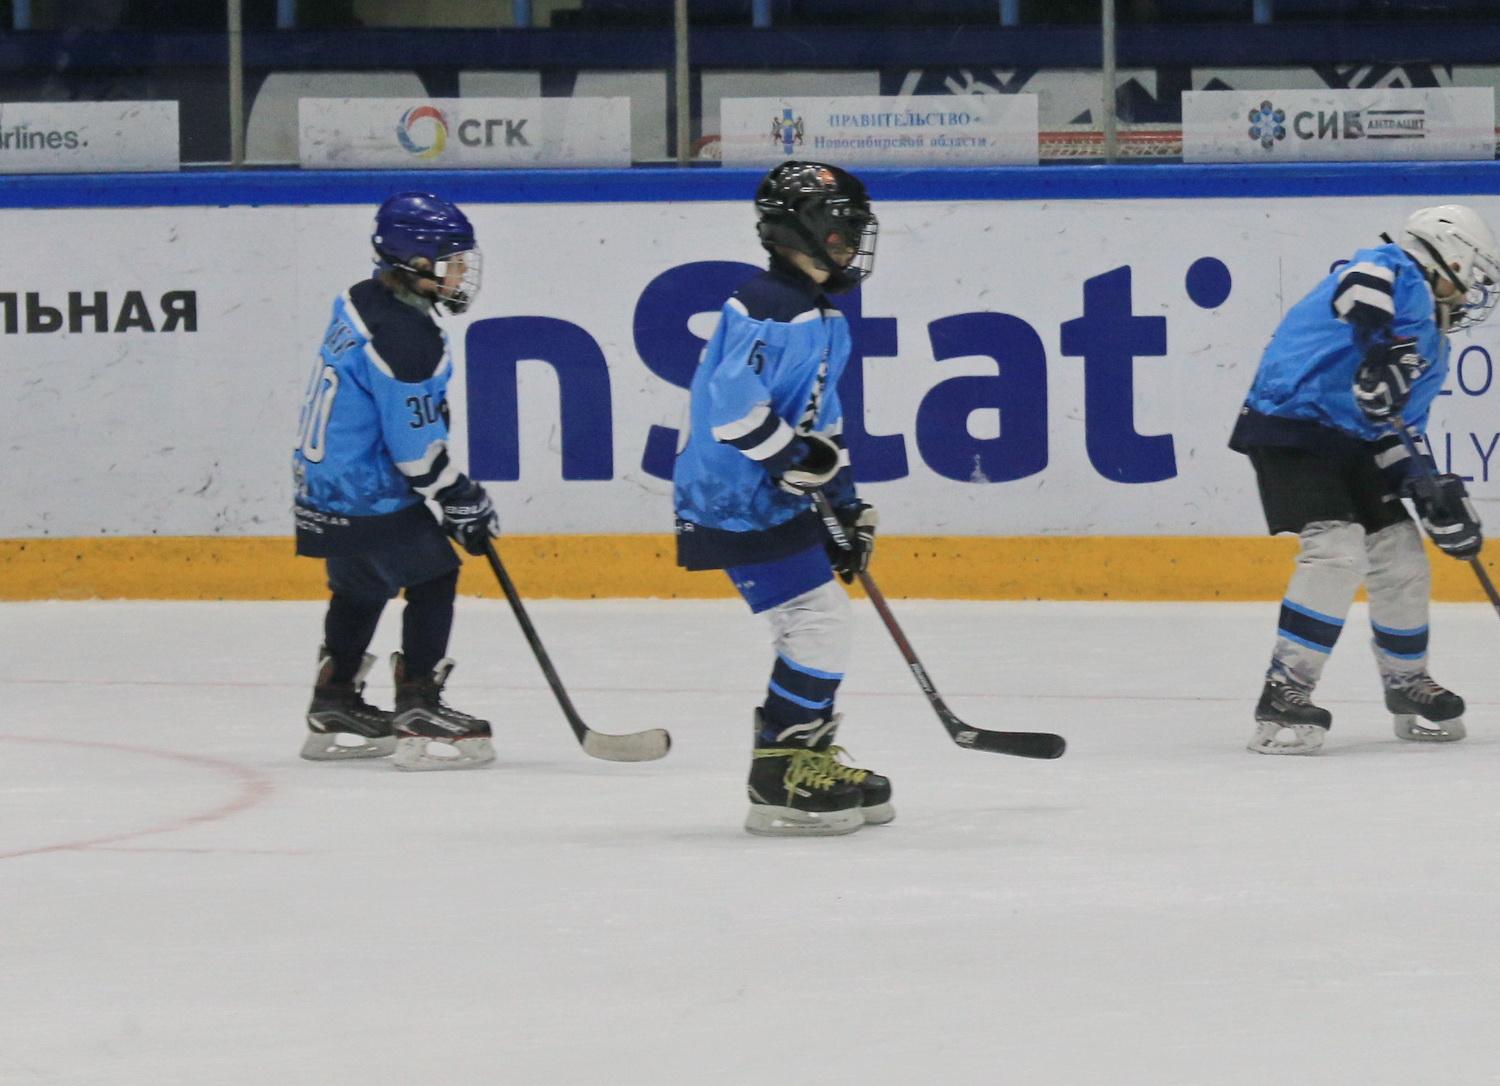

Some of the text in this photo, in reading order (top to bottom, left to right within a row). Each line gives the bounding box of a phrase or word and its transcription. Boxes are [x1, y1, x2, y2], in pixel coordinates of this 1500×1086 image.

[457, 118, 531, 147] СГК
[828, 112, 971, 128] ПРАВИТЕЛЬСТВО
[1293, 110, 1366, 140] СИБ
[814, 135, 987, 151] Новосибирской области
[465, 261, 1178, 484] nStat
